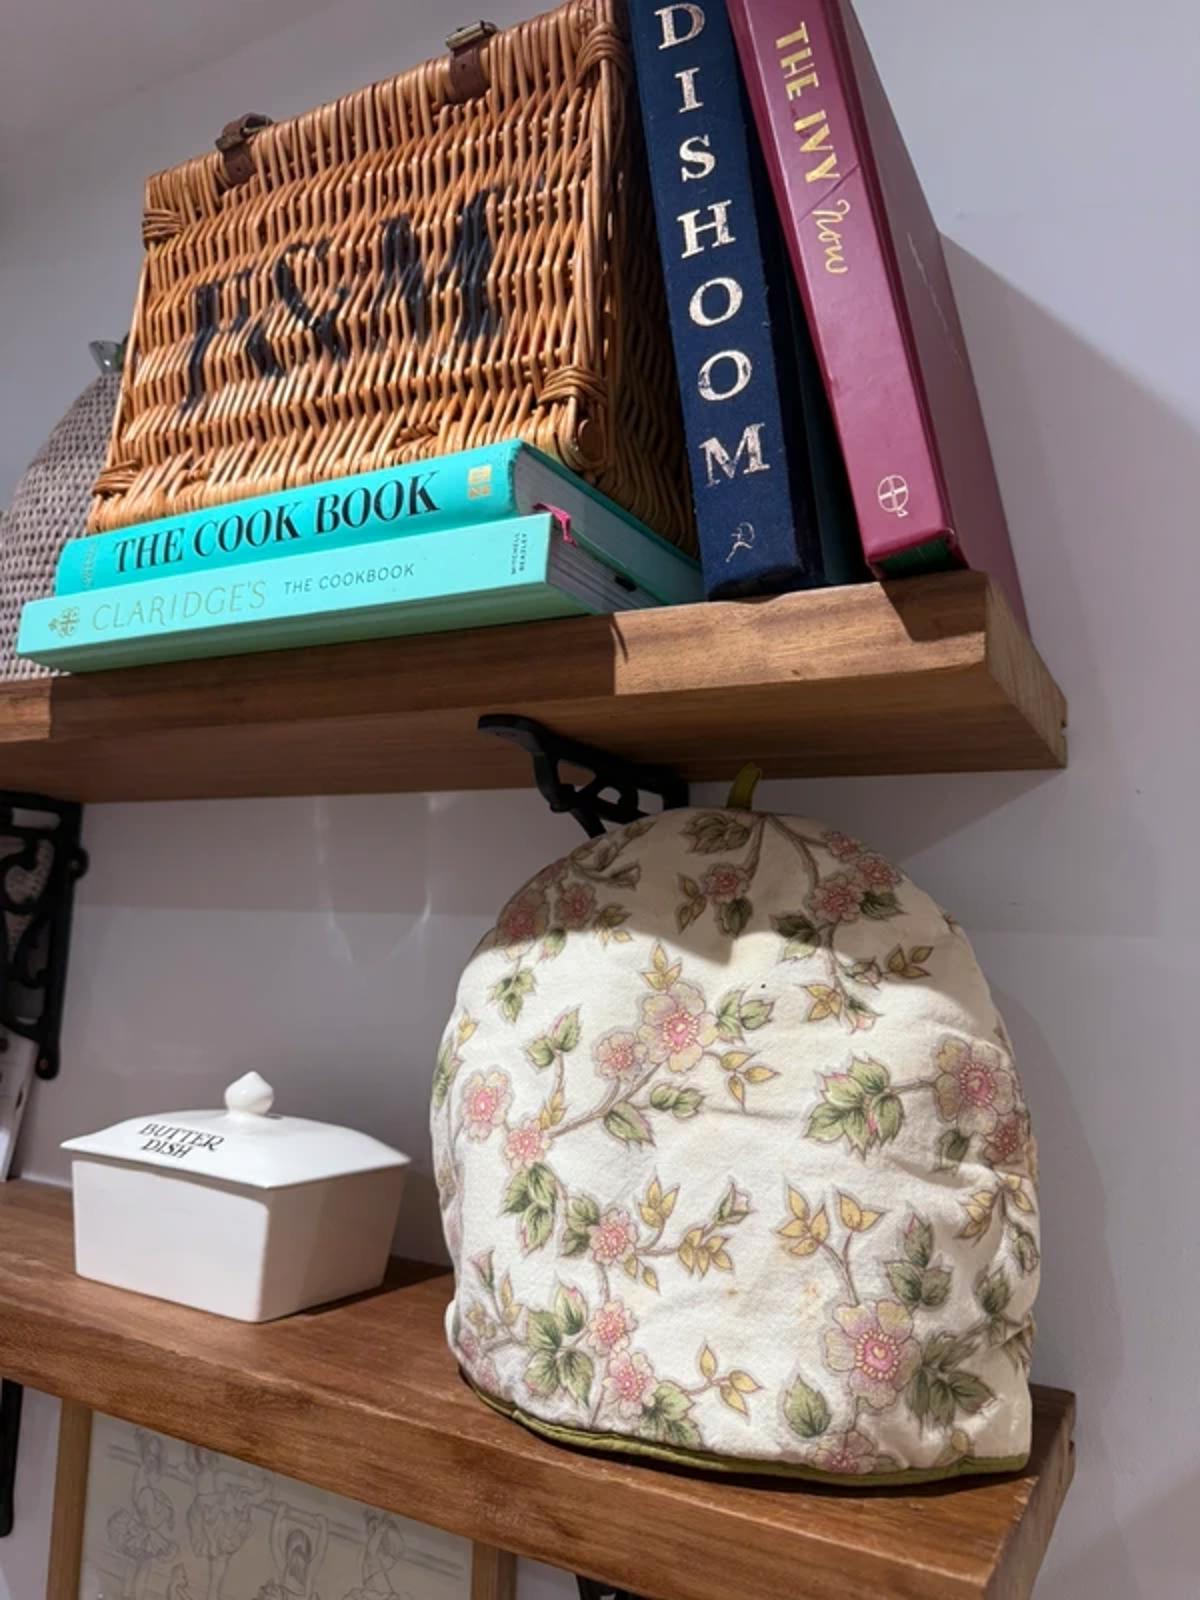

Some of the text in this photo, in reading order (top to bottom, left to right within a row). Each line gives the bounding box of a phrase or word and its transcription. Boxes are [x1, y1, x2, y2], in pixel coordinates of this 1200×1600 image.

[776, 21, 850, 275] THE IVY Now
[656, 1, 770, 487] DISHOOM
[113, 527, 186, 574] THE
[193, 500, 303, 557] COOK
[313, 471, 442, 535] BOOK
[91, 562, 416, 632] CLARIDGE'S THE COOKBOOK
[138, 1122, 225, 1152] BUTTER
[141, 1138, 194, 1159] DISH
